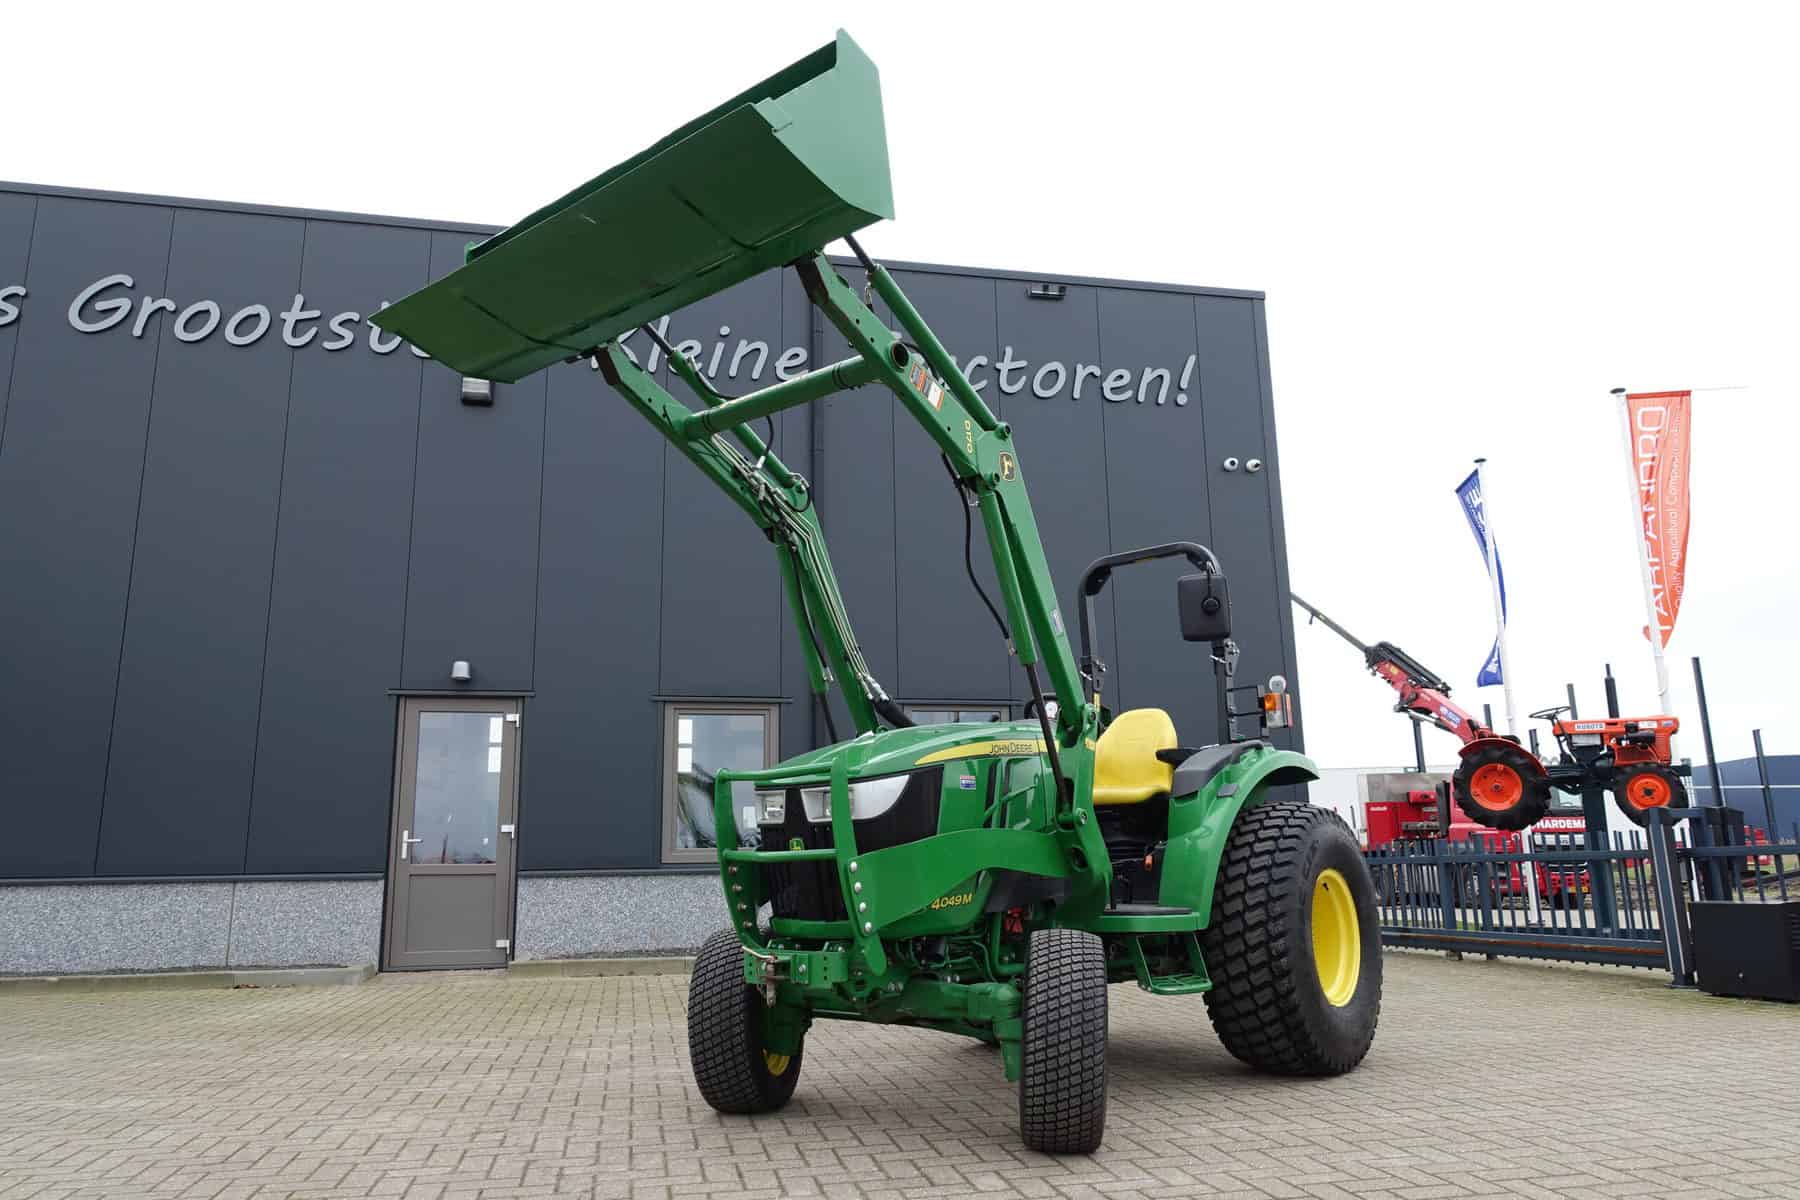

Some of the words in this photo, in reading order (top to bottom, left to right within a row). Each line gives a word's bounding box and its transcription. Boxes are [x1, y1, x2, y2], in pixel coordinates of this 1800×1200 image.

[68, 274, 432, 357] Grootst
[892, 331, 1196, 405] ctoren!
[930, 893, 973, 911] 4049M
